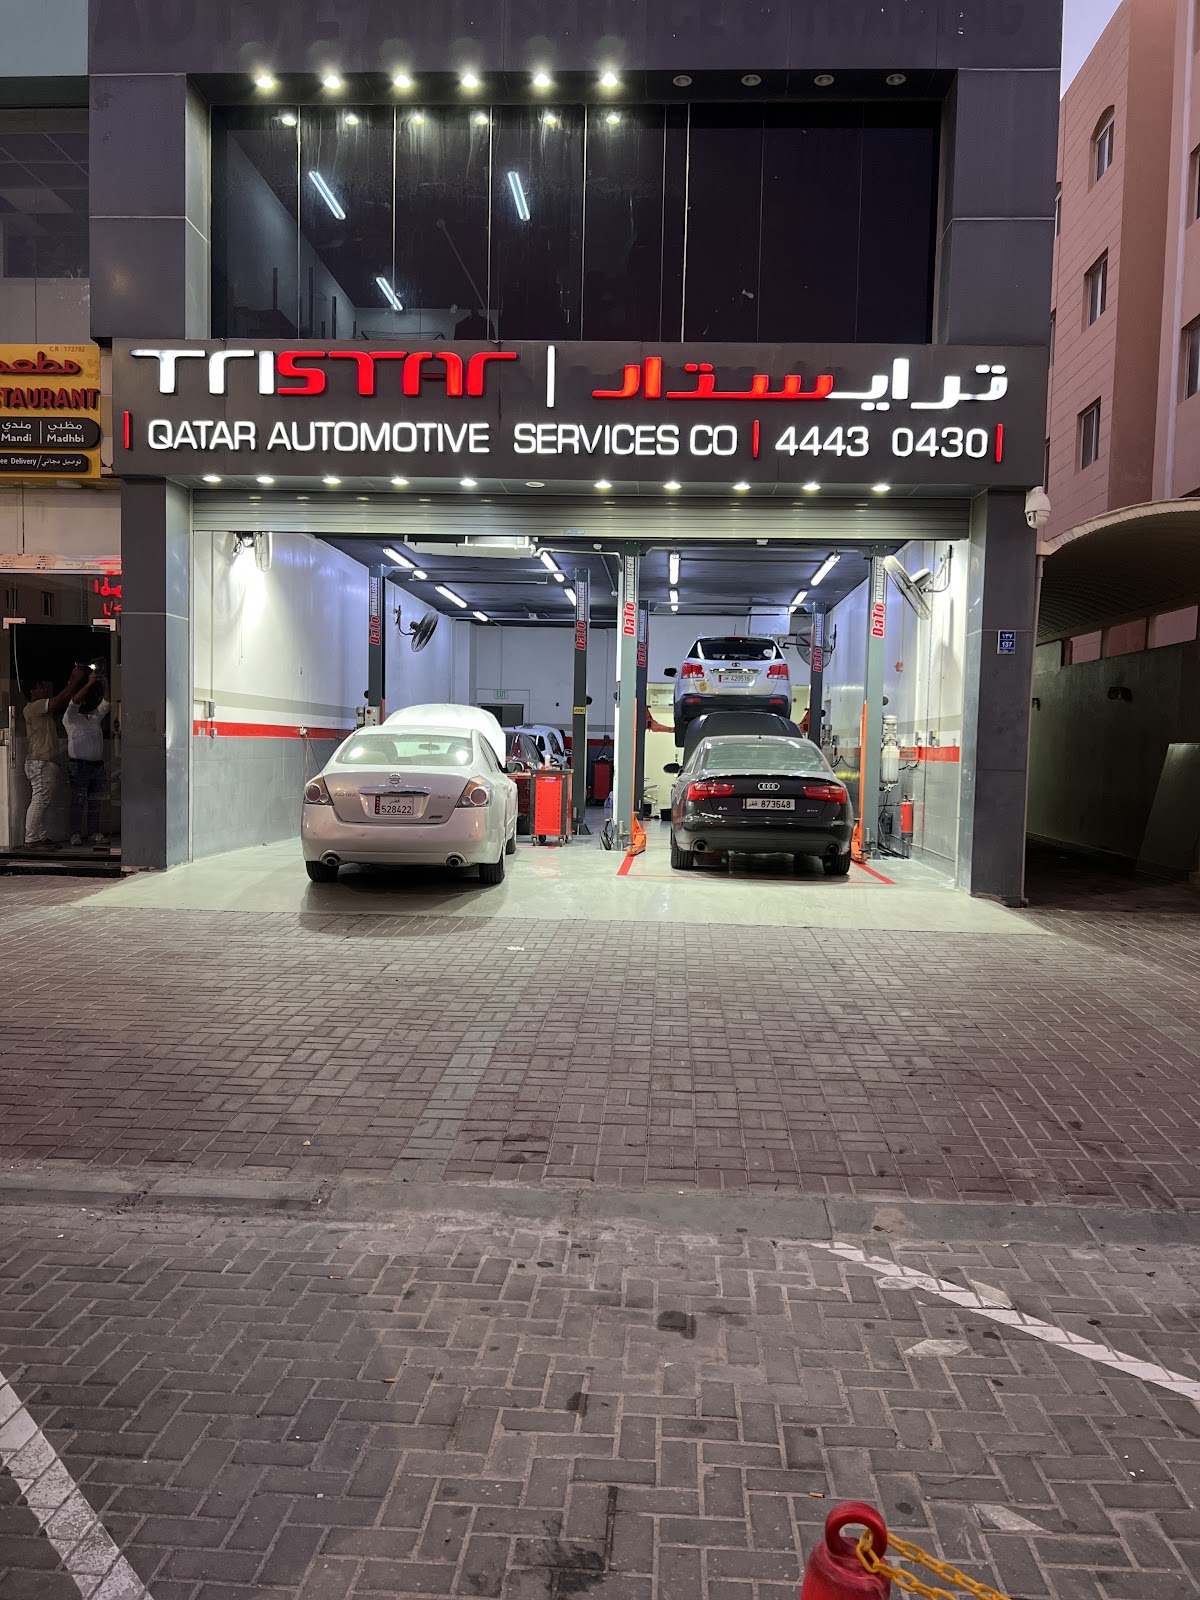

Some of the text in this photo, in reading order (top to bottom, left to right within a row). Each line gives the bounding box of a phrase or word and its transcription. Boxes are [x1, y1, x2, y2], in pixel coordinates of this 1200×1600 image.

[129, 349, 517, 397] TRISTAR
[0, 388, 98, 408] TAURANT
[2, 421, 82, 433] مظبي مندي
[1, 433, 84, 443] Mandi Madhbi
[148, 419, 988, 459] QATAR AUTOMOTIVE SERVICES CO 4443 0430
[11, 457, 37, 466] Delivery
[623, 602, 636, 636] DaTo
[871, 603, 885, 638] DaTo
[496, 690, 506, 698] EXIT
[381, 805, 412, 814] 528422
[760, 800, 791, 809] 873648
